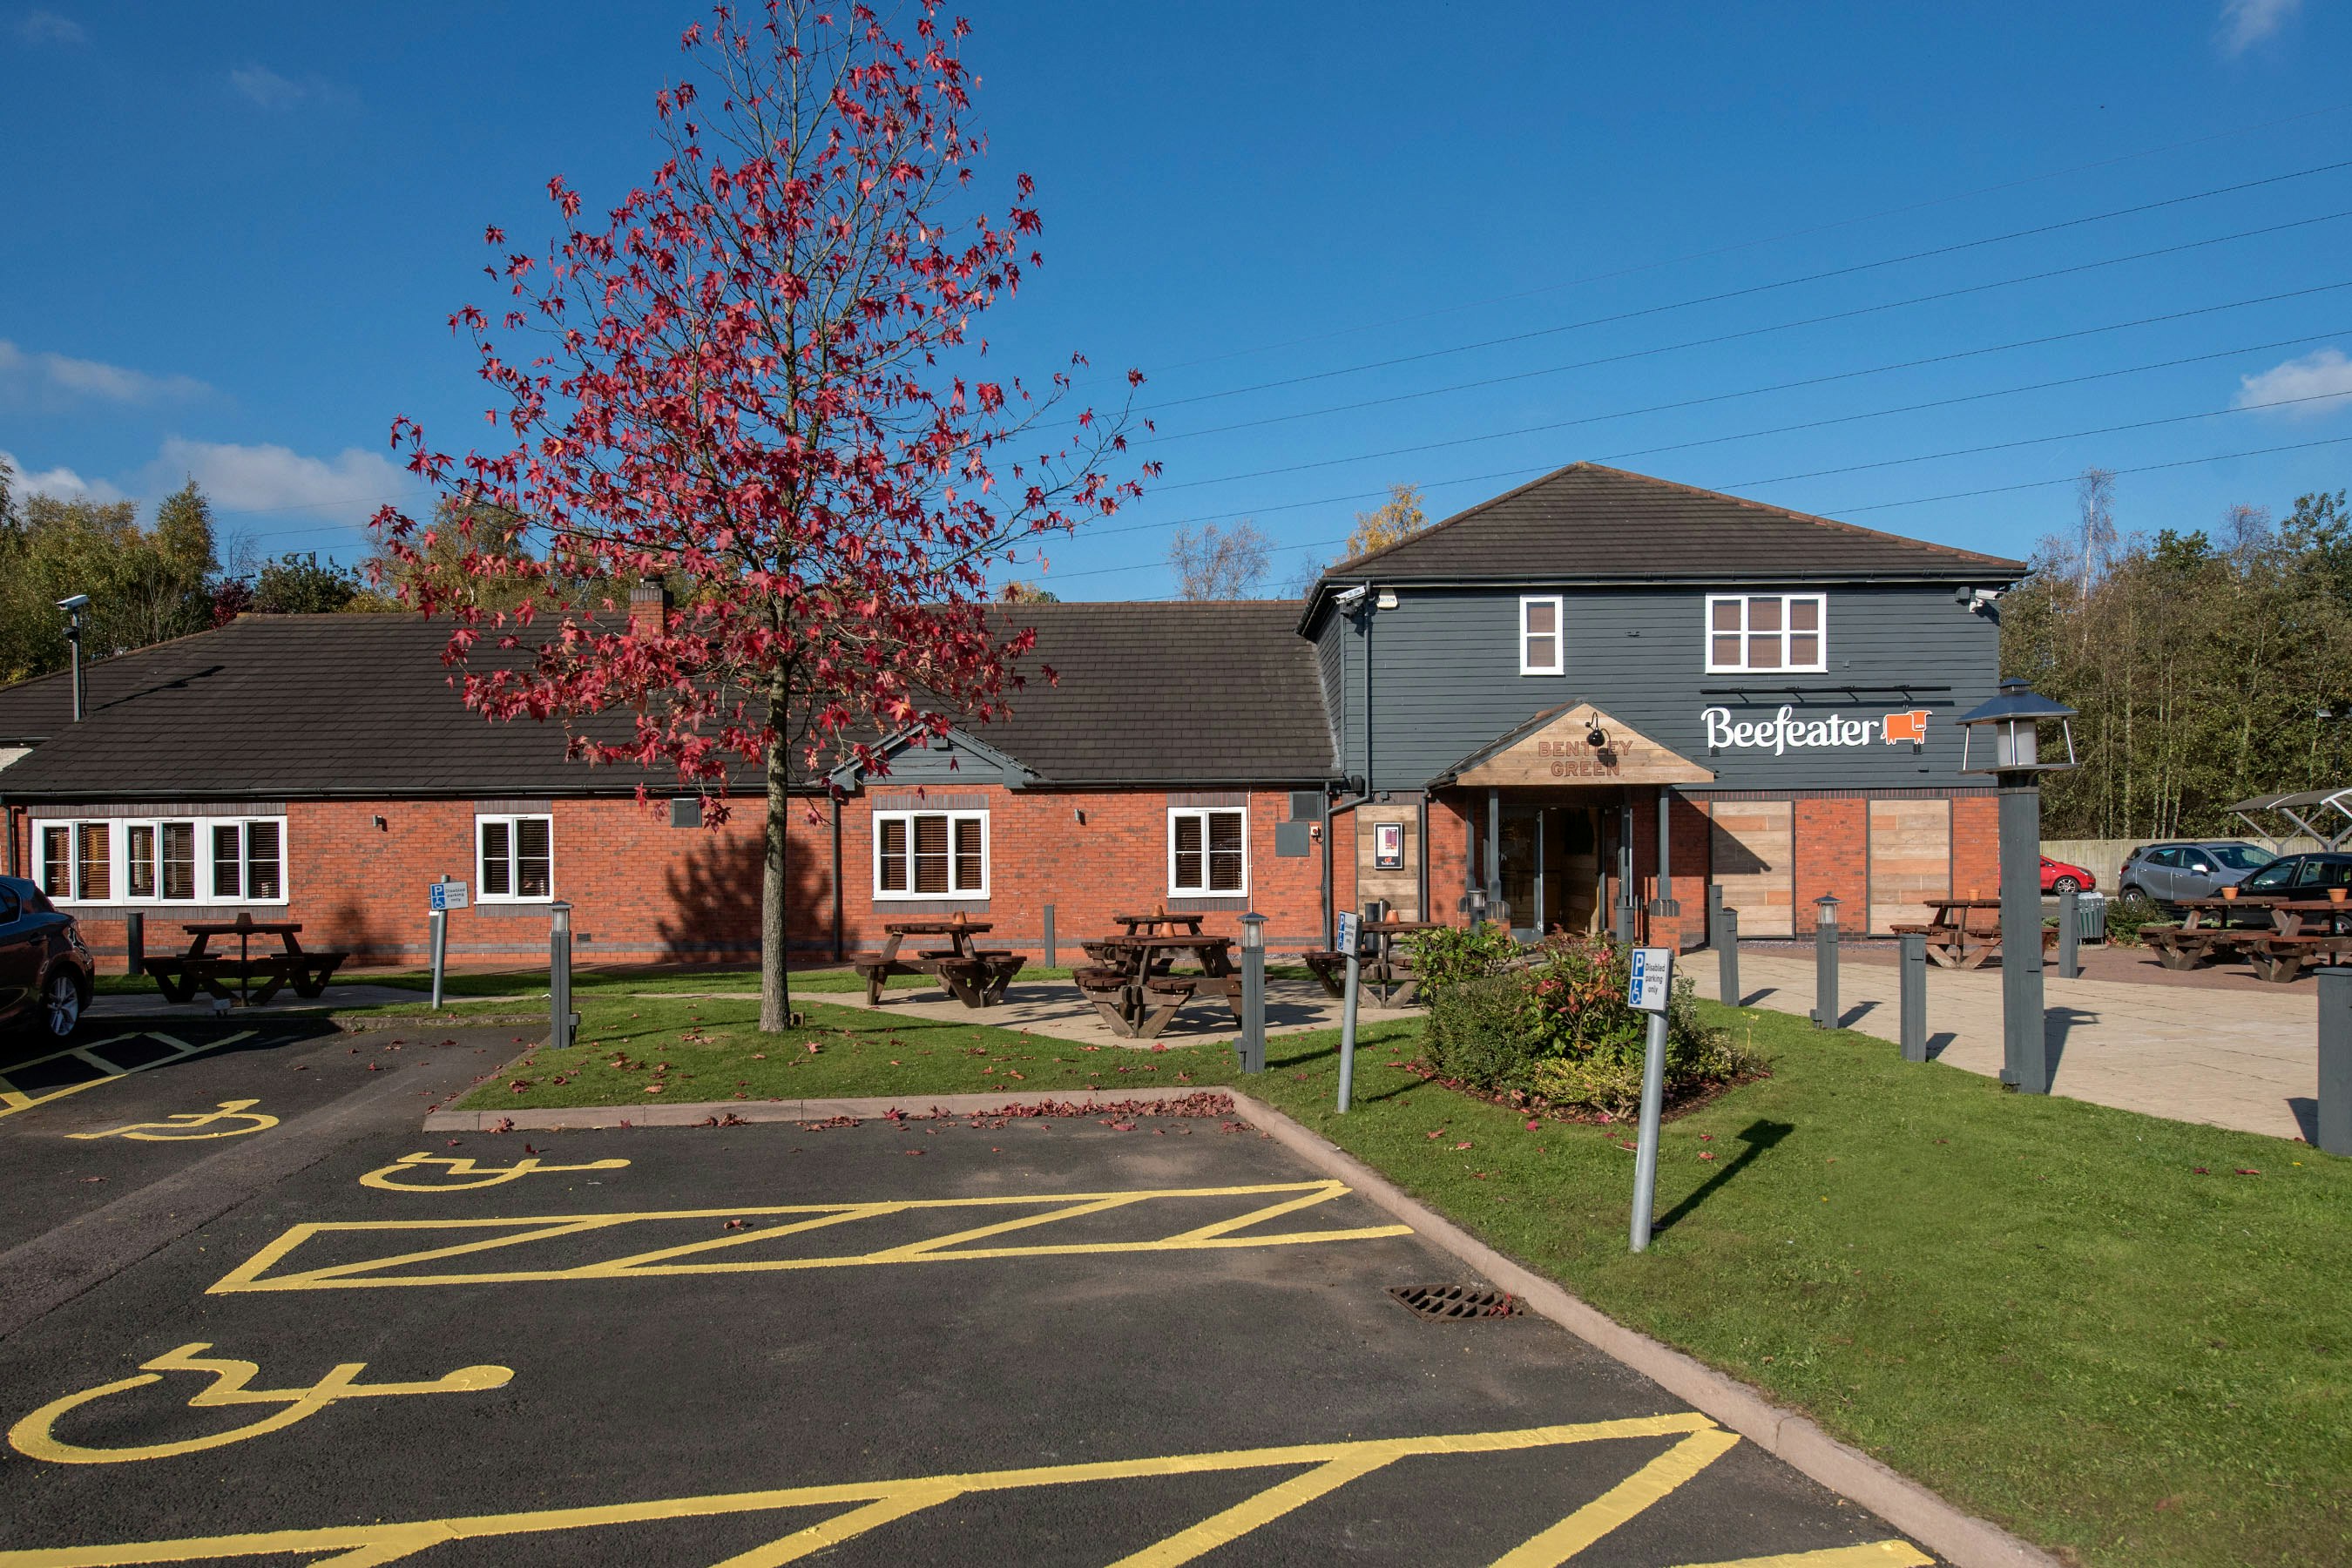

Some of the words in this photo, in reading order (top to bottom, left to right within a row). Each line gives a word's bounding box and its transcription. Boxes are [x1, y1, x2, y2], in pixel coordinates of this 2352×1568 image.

[1700, 704, 1880, 757] Beefeater
[1538, 740, 1633, 757] BENTLEY
[1551, 760, 1620, 777] GREEN
[434, 886, 443, 896] P
[1339, 915, 1345, 931] P
[1635, 954, 1644, 976] P
[1645, 963, 1666, 972] Disabled
[1645, 975, 1663, 984] parking
[1648, 985, 1659, 995] only
